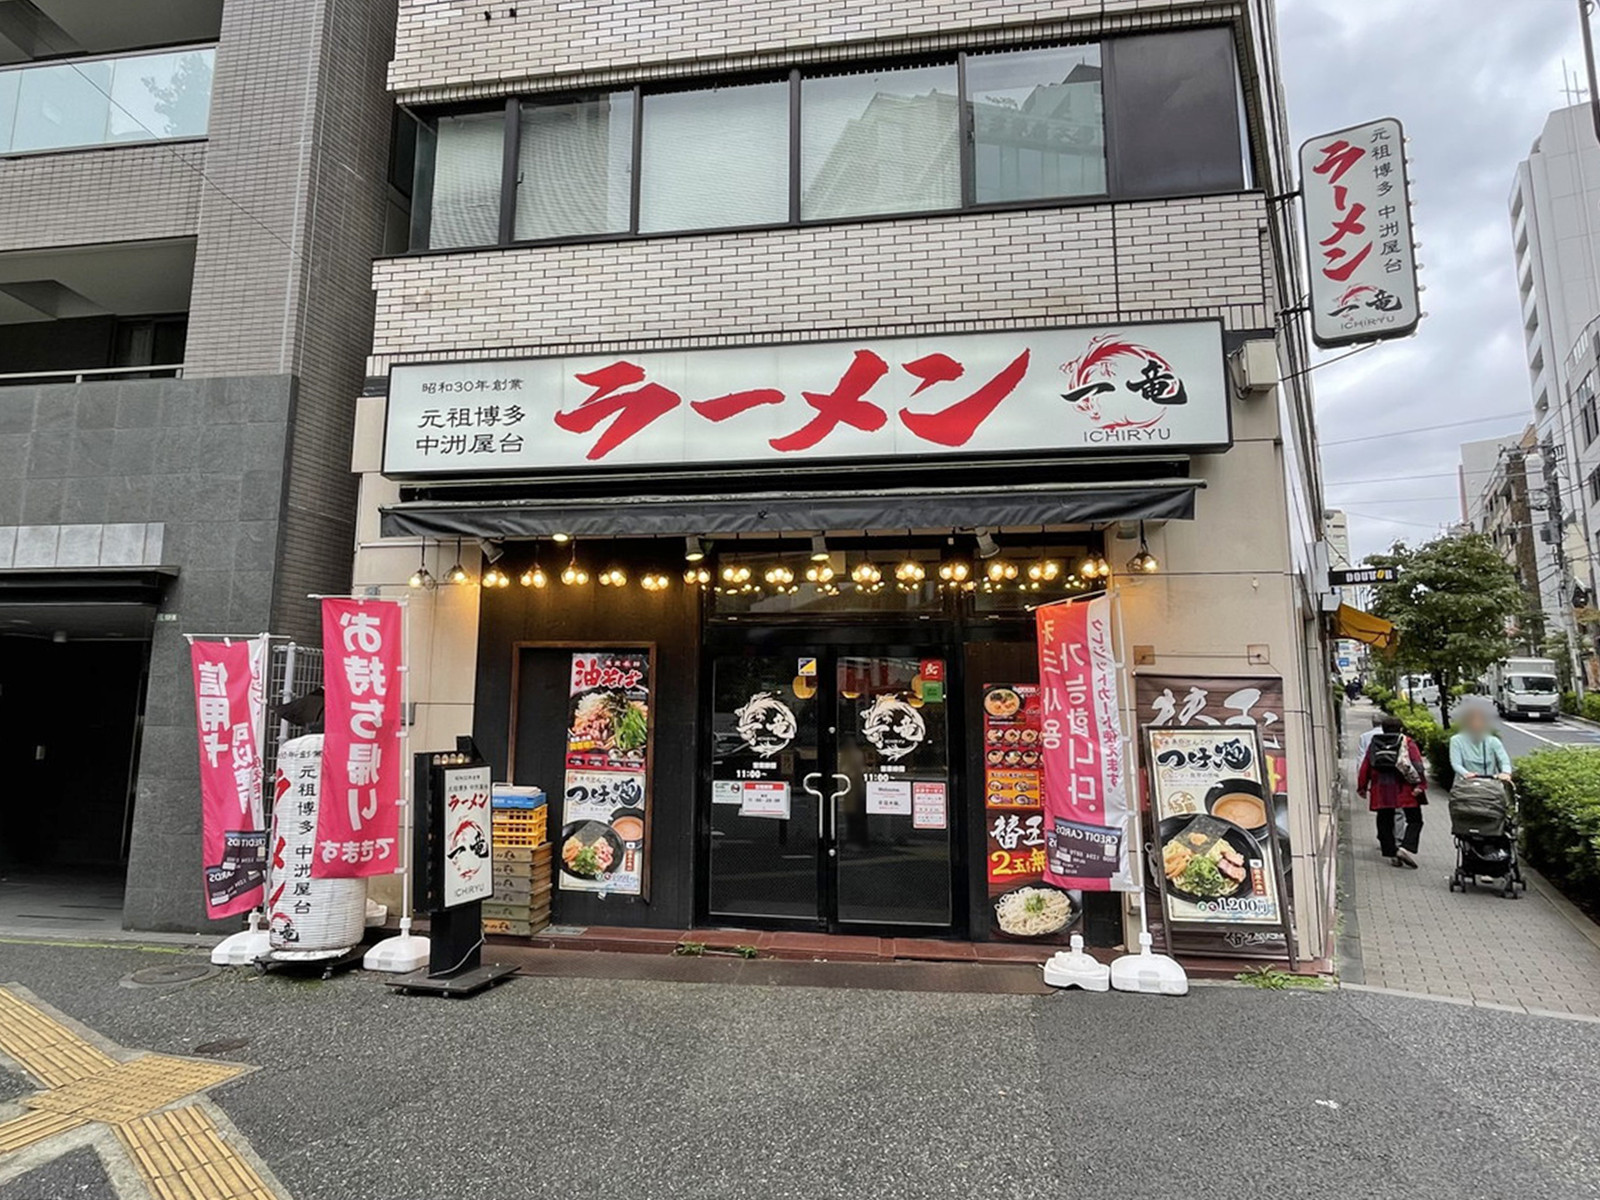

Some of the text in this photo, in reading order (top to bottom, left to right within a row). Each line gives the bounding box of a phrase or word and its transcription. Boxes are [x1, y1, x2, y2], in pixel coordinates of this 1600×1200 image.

[1313, 140, 1373, 281] ラーメン
[1371, 127, 1402, 274] 元祖博多 中洲屋台
[1327, 289, 1403, 317] 一竜
[1341, 315, 1396, 330] ICHIRYU
[422, 378, 525, 394] 昭和30年創業
[1060, 358, 1189, 405] 一竜
[417, 404, 526, 428] 元祖博多
[553, 347, 1031, 461] ラーメン
[415, 432, 525, 456] 中洲屋台
[1083, 428, 1171, 443] ICHIRYU
[1346, 570, 1392, 582] DOUTOR
[574, 658, 643, 688] 油そば
[297, 765, 318, 835] 元祖博多
[448, 793, 489, 813] ラーメン
[293, 844, 313, 915] 中洲屋台
